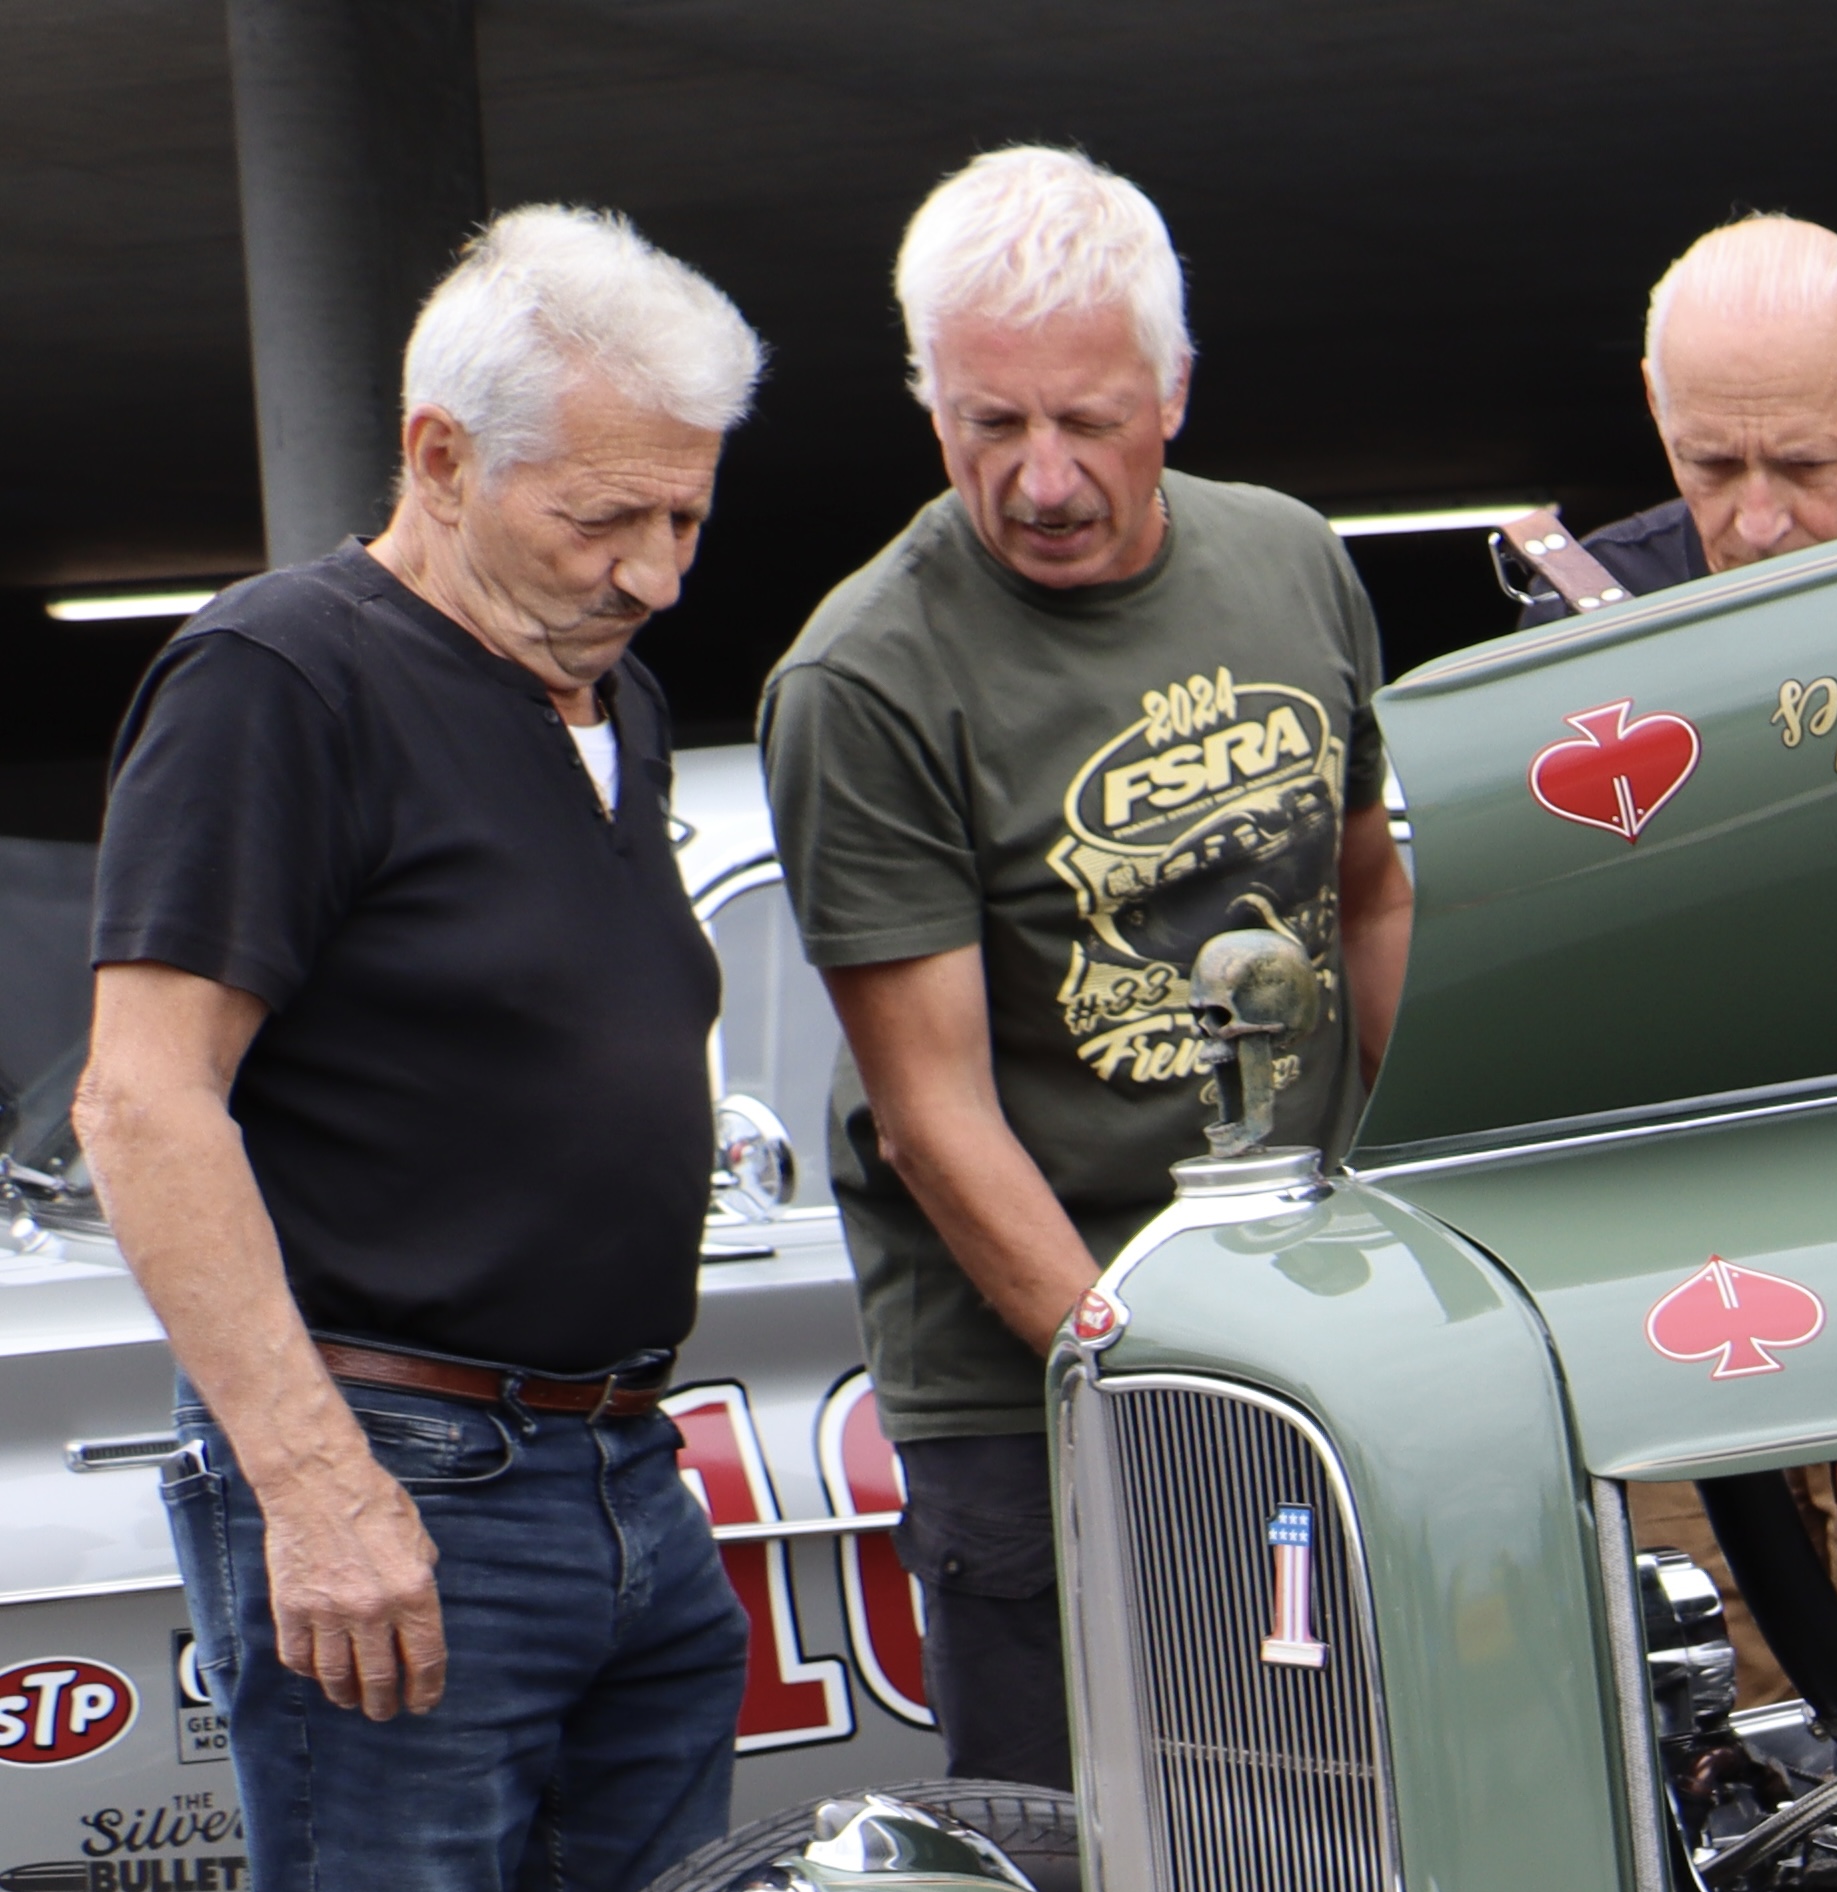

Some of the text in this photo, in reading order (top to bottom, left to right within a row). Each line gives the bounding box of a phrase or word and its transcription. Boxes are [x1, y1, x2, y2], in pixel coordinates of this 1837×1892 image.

[1142, 665, 1236, 748] 2024
[1104, 706, 1311, 826] FSRA
[0, 1669, 116, 1749] STP
[81, 1807, 244, 1857] Silver
[173, 1792, 213, 1810] THE
